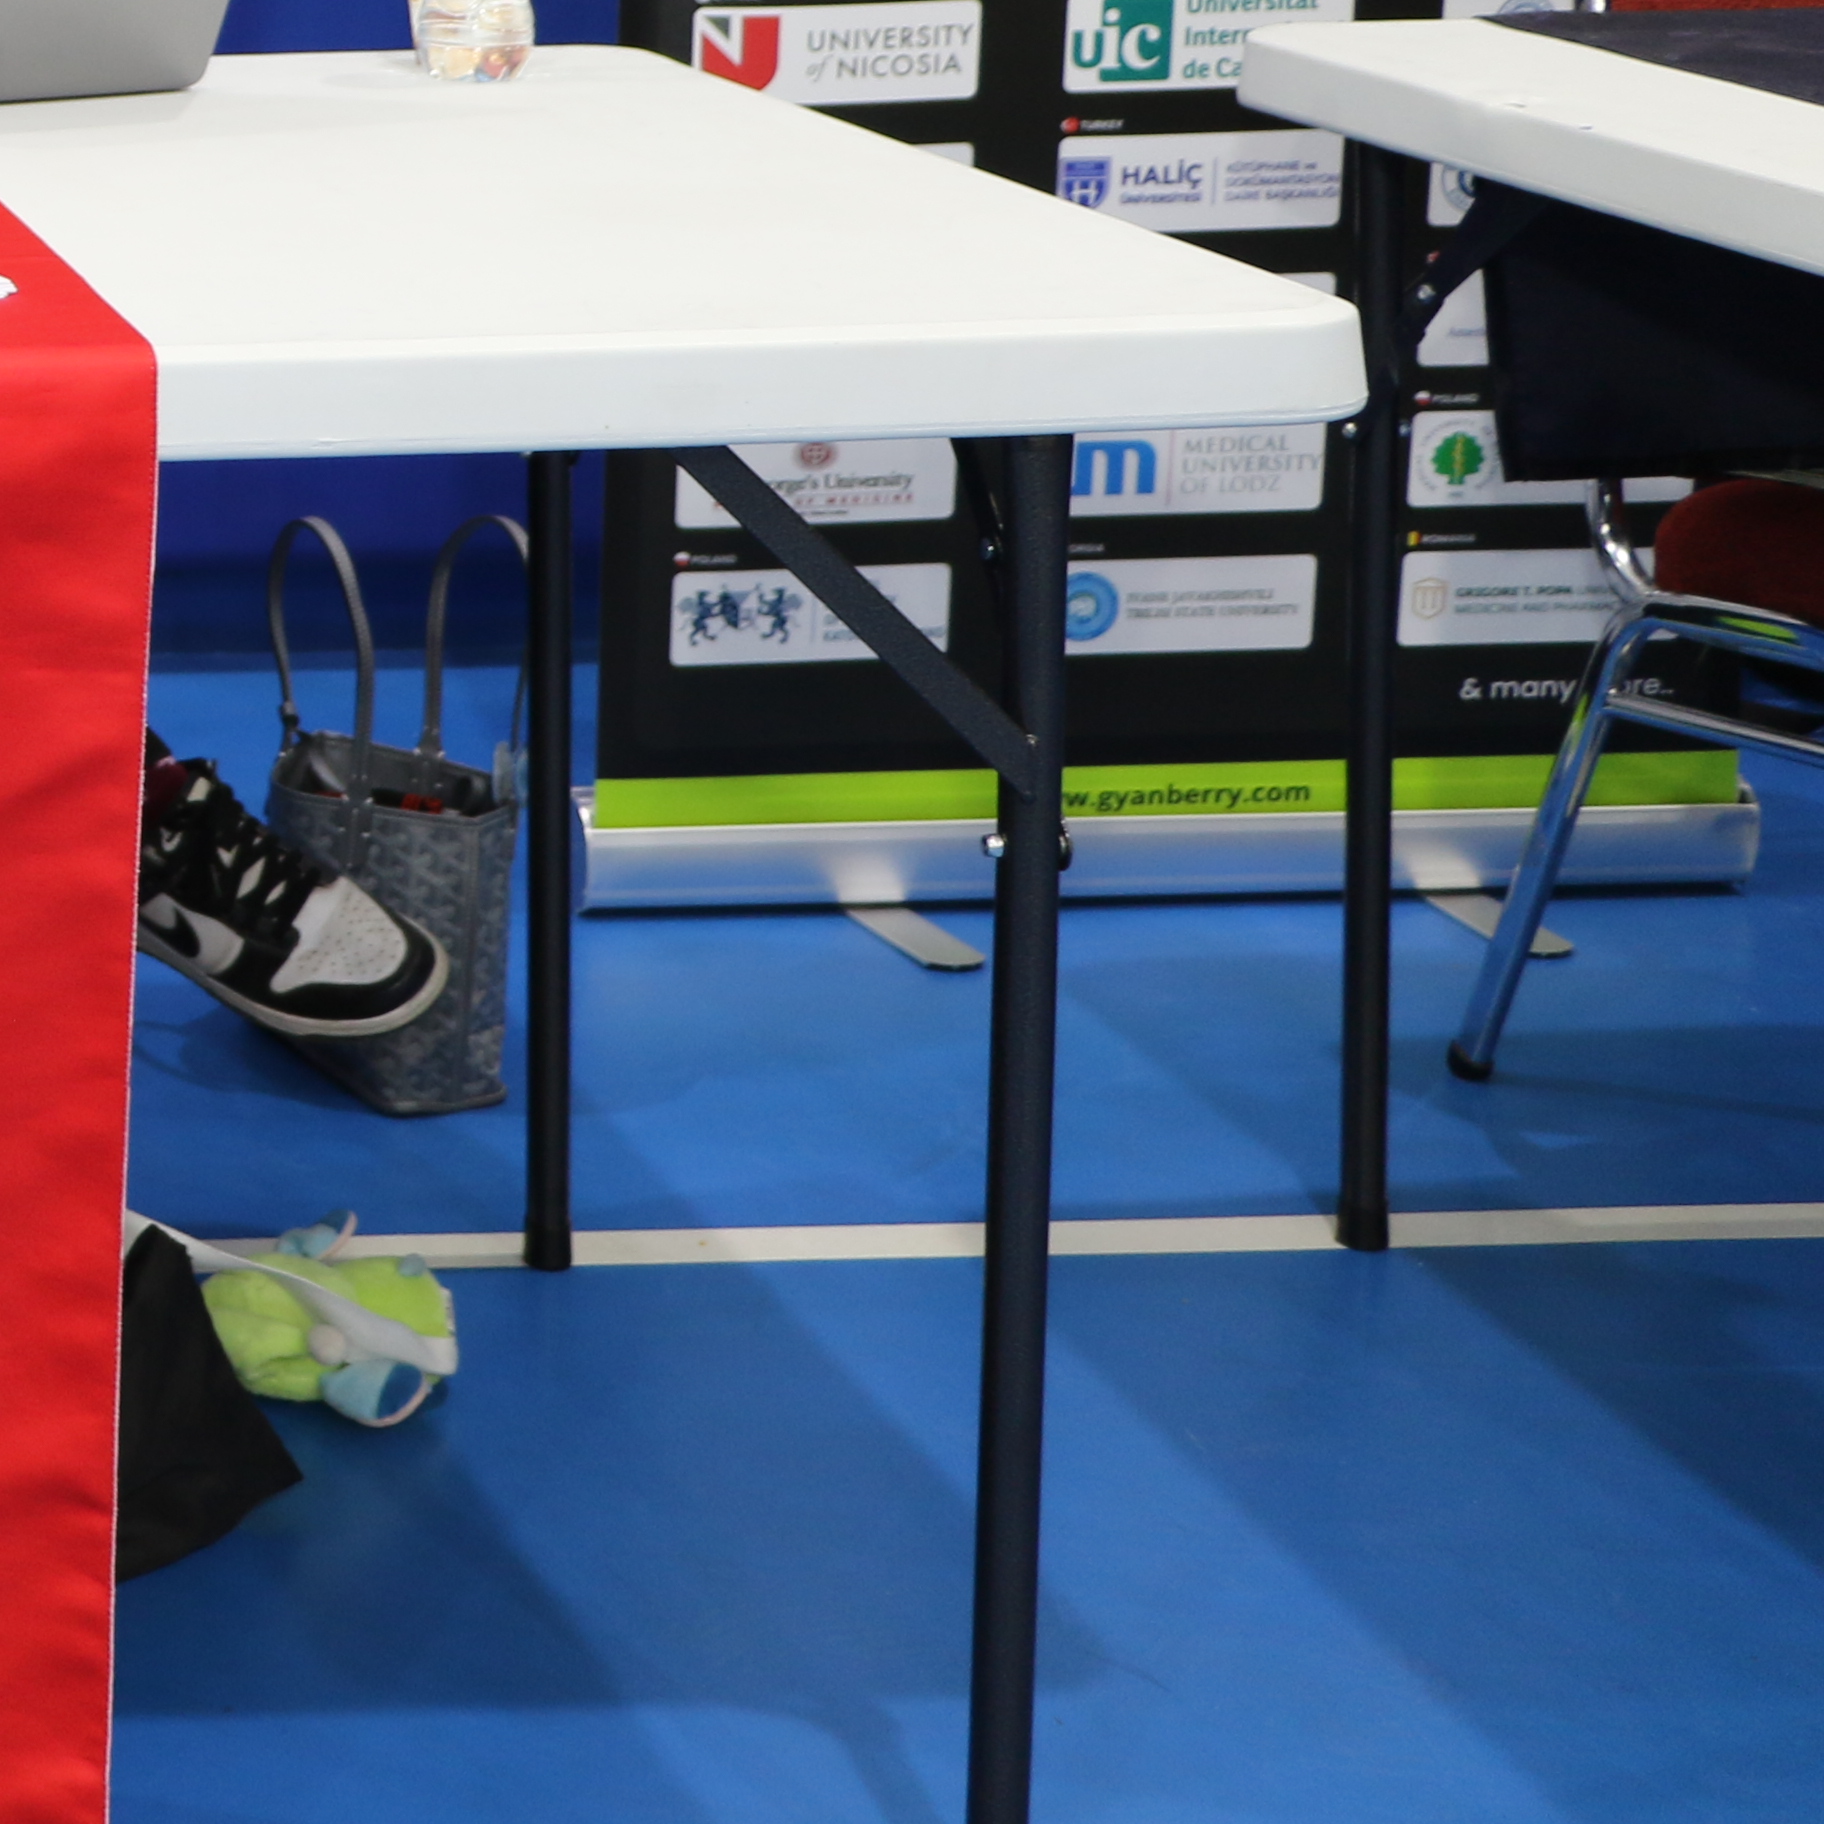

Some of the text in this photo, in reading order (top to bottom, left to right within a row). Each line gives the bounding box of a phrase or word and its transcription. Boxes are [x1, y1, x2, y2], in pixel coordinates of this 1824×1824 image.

[806, 23, 975, 53] UNIVERSITY
[1072, 7, 1162, 70] uic
[806, 53, 964, 83] of NICOSIA
[1183, 58, 1212, 79] de
[1120, 158, 1203, 189] HALİÇ
[1183, 433, 1291, 454] MEDICAL
[1181, 452, 1323, 475] UNIVERSITY
[1180, 477, 1208, 494] OF
[1459, 677, 1578, 705] & many
[1062, 781, 1312, 813] w.gyanberry.com
